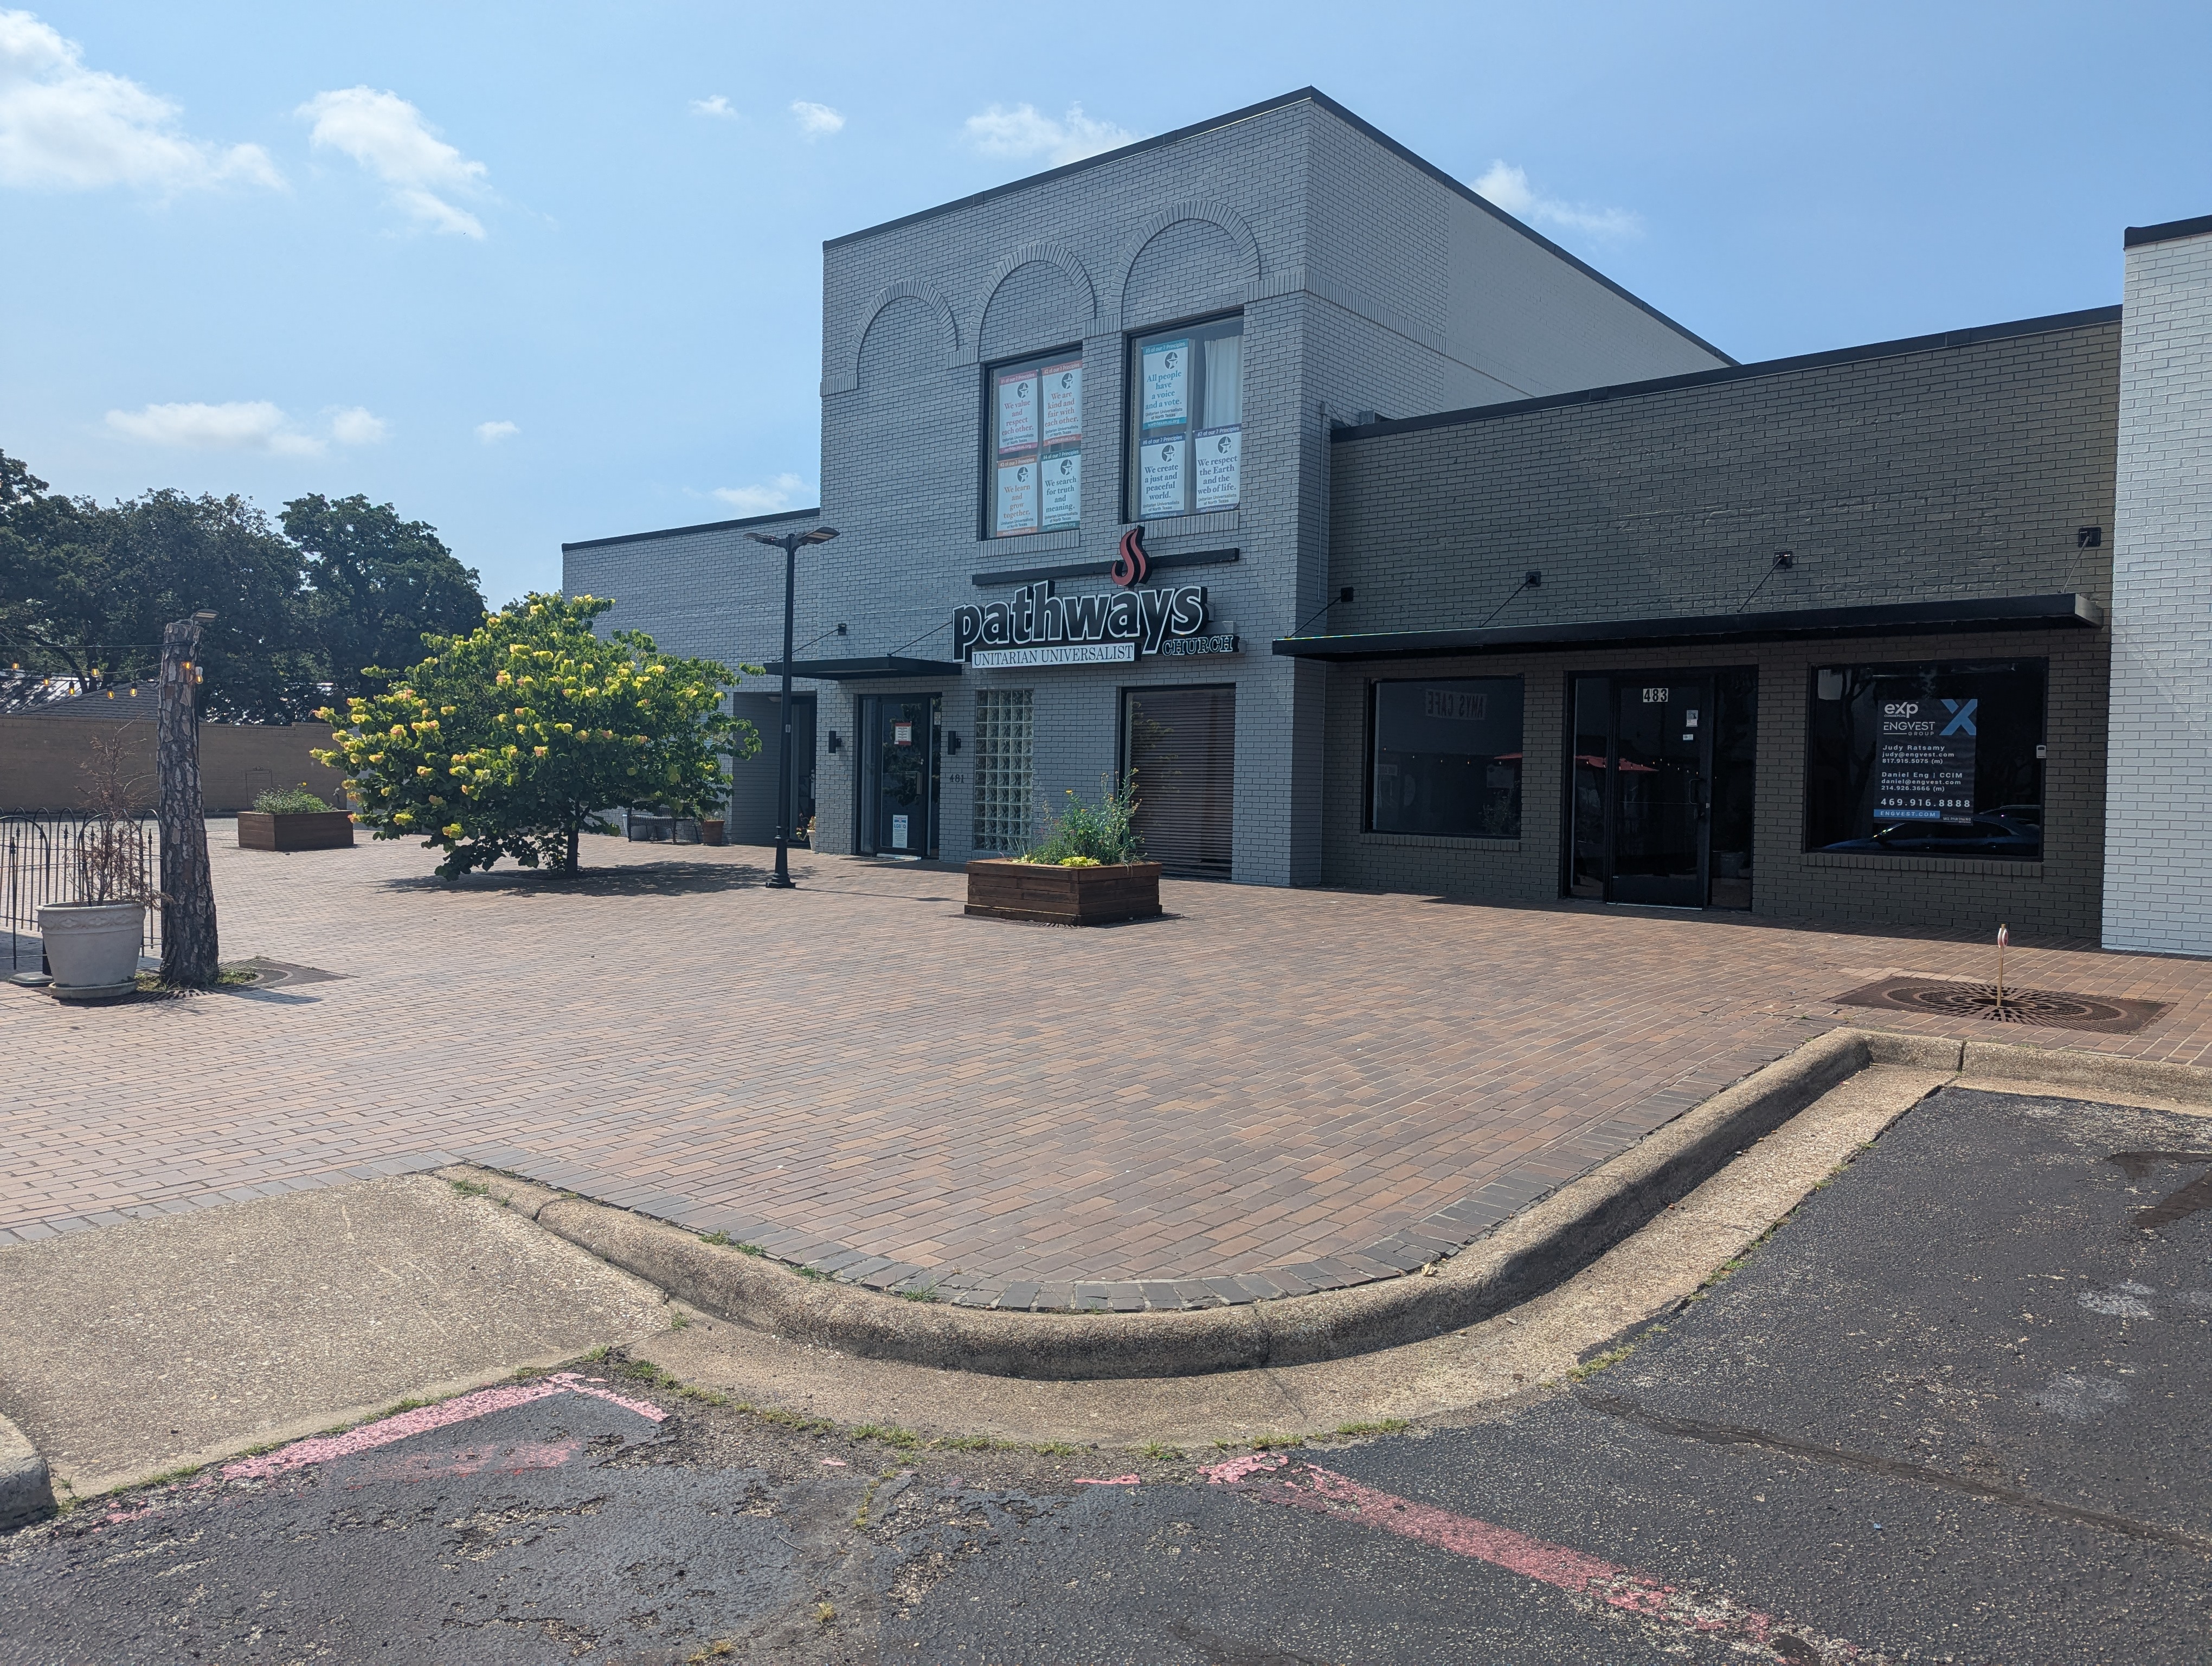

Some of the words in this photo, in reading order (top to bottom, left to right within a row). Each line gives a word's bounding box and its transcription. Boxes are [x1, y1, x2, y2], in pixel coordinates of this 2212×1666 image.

[1167, 342, 1185, 350] Principles
[1147, 374, 1157, 382] All
[1158, 370, 1181, 382] people
[1157, 390, 1175, 398] voice
[1048, 400, 1062, 409] kind
[1063, 398, 1075, 407] and
[1146, 401, 1158, 409] and
[1012, 409, 1023, 417] and
[1048, 409, 1059, 418] fair
[1060, 407, 1075, 415] with
[1006, 418, 1027, 426] respect
[1045, 418, 1057, 427] each
[1002, 426, 1014, 435] each
[1211, 456, 1237, 466] respect
[1157, 464, 1178, 472] create
[1213, 465, 1234, 474] Earth
[1057, 476, 1077, 485] search
[1149, 475, 1163, 484] just
[1165, 472, 1178, 480] and
[1203, 475, 1217, 484] and
[1058, 485, 1075, 495] truth
[1146, 481, 1175, 494] peaceful
[1198, 485, 1211, 495] web
[1221, 483, 1236, 491] life.
[1054, 495, 1066, 503] and
[1149, 491, 1171, 500] world.
[1010, 503, 1024, 511] grow
[1046, 503, 1075, 512] meaning.
[1004, 510, 1030, 520] together.
[953, 579, 1204, 662] pathways
[1162, 635, 1233, 656] CHURCH
[974, 650, 1037, 666] UNITARIAN
[1041, 645, 1133, 662] UNIVERSALIST
[1644, 689, 1667, 701] 483
[1883, 722, 1935, 730] ENGVEST
[950, 774, 964, 783] 481
[1881, 798, 1970, 807] 469.916.8888
